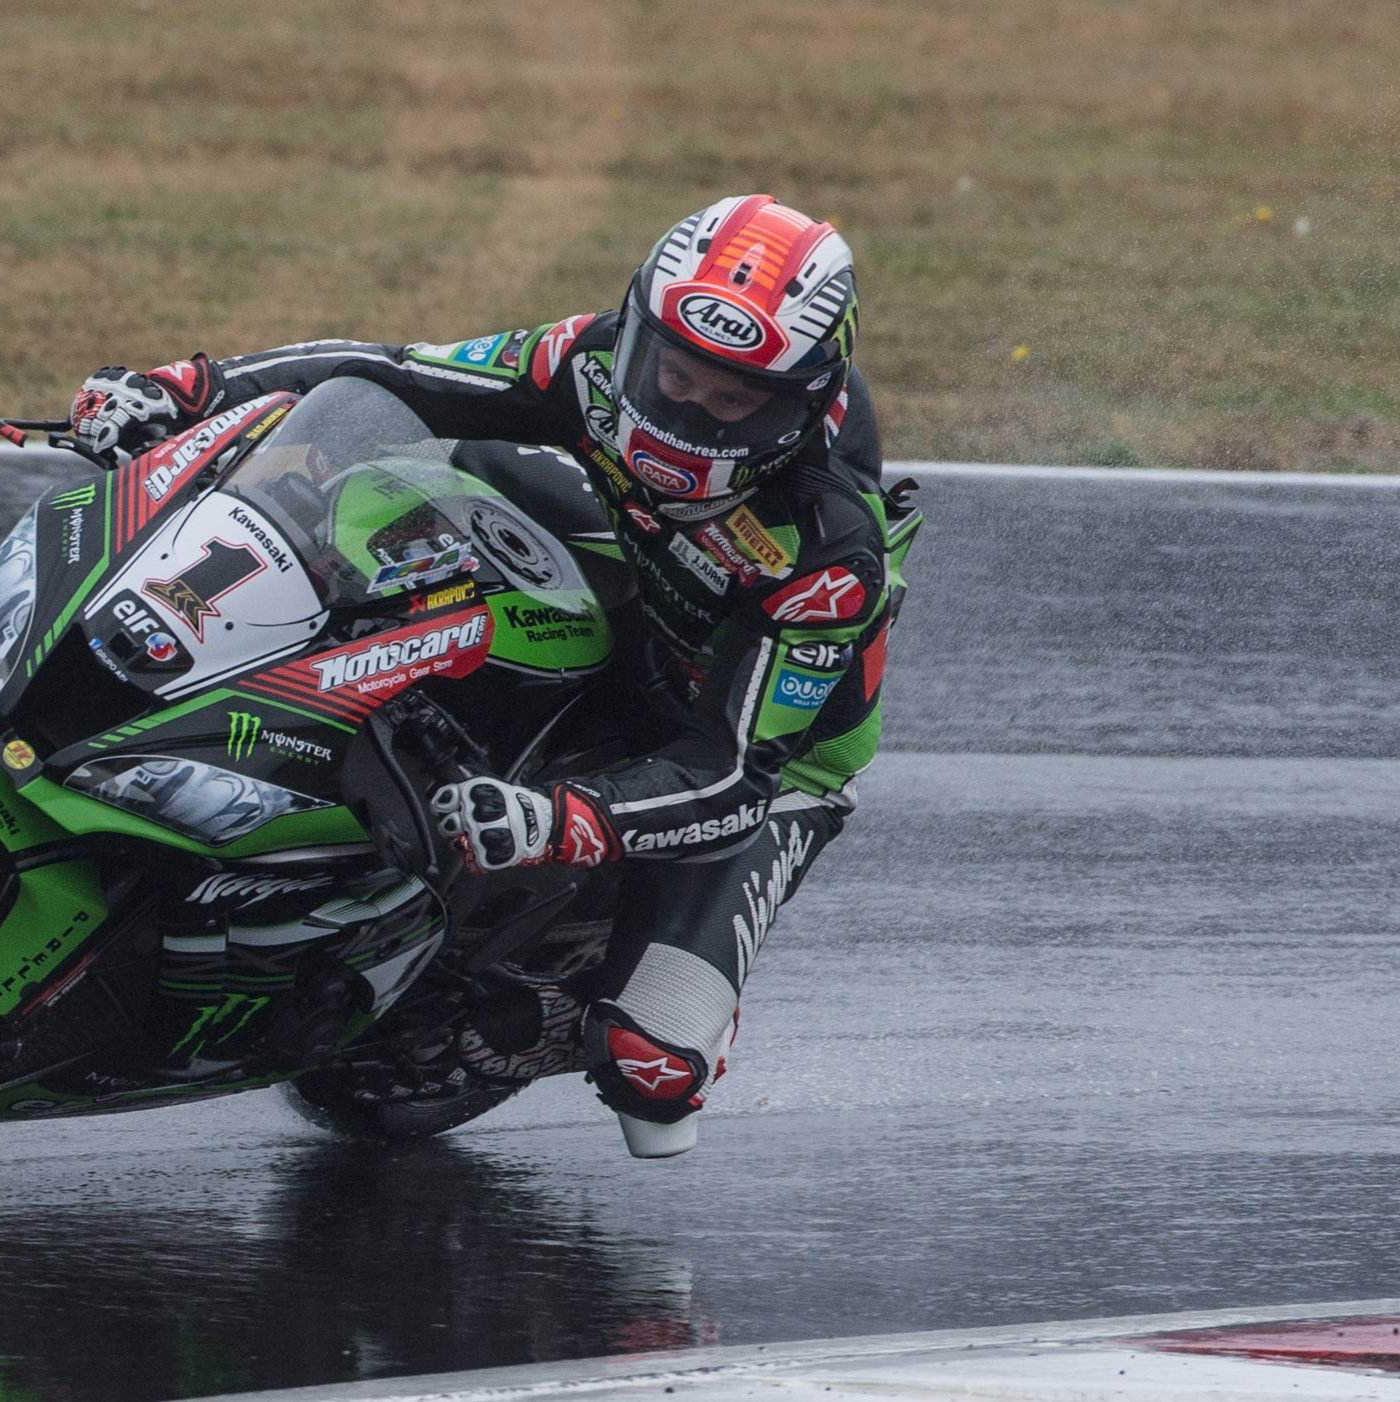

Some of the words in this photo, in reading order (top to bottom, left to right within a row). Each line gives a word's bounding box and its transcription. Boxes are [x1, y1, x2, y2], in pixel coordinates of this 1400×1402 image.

[684, 302, 756, 341] Arai
[620, 394, 749, 458] www.jonathan-rea.com
[641, 463, 681, 489] PATA
[67, 507, 84, 564] MONSTER
[228, 506, 293, 574] Kawasaki
[733, 511, 784, 568] PIRELLI
[141, 536, 268, 645] 1
[692, 555, 726, 589] J.JUAN
[113, 599, 160, 634] elf
[526, 628, 568, 644] Racing
[569, 625, 594, 640] Team
[95, 648, 118, 672] GRUPO
[791, 644, 840, 668] elf
[358, 672, 407, 695] Motorcycle
[409, 665, 432, 679] Gear
[433, 659, 453, 673] Store
[260, 729, 332, 761] MONSTER
[621, 799, 767, 852] Kawasaki
[732, 820, 815, 991] Ninja
